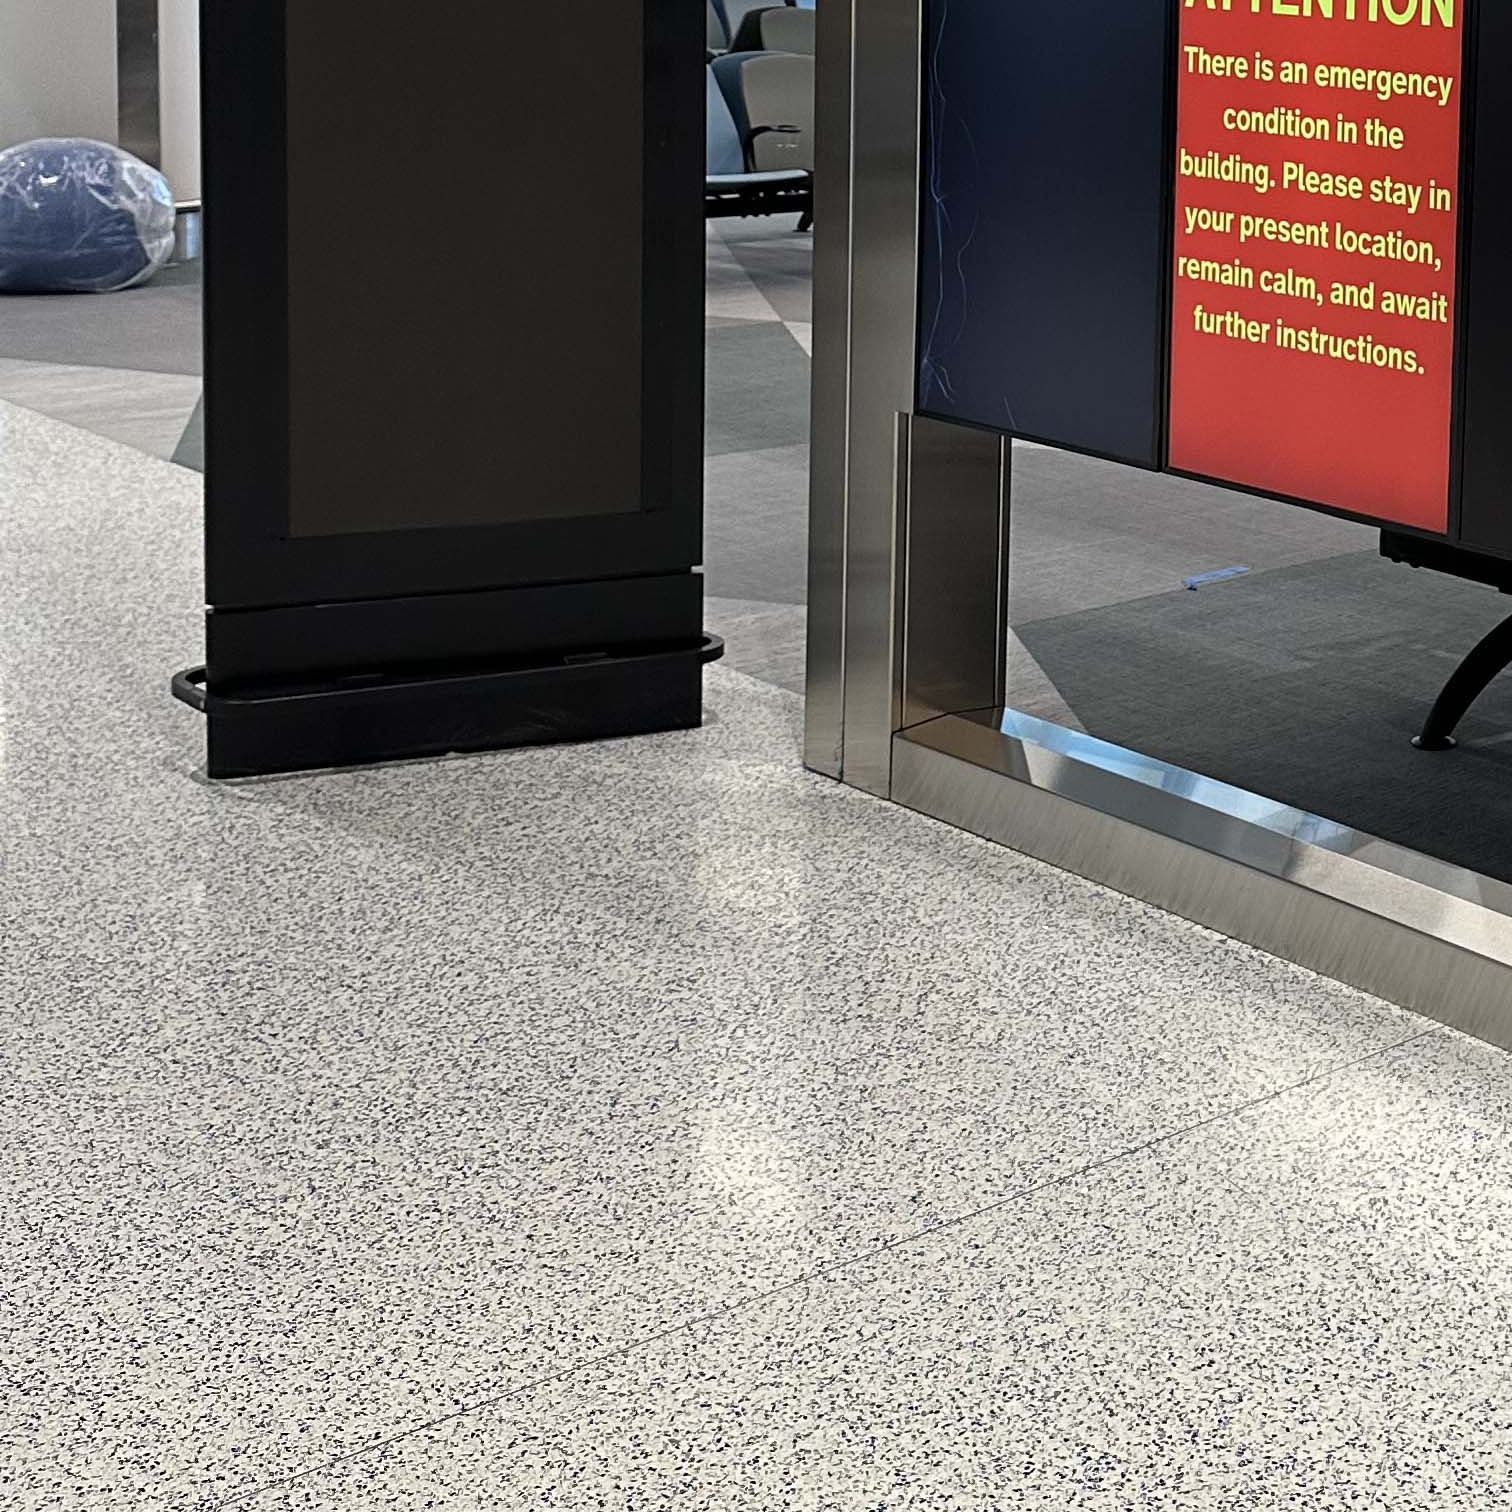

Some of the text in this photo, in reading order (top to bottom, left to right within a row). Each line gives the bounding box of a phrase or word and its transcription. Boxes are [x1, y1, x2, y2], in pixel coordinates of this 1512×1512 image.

[1183, 45, 1454, 106] There is an emergency
[1223, 106, 1404, 150] condition in the
[1180, 147, 1451, 214] building. Please stay in
[1184, 206, 1442, 271] your present location,
[1178, 256, 1448, 323] remain calm, and await
[1193, 304, 1425, 374] further instructions.
